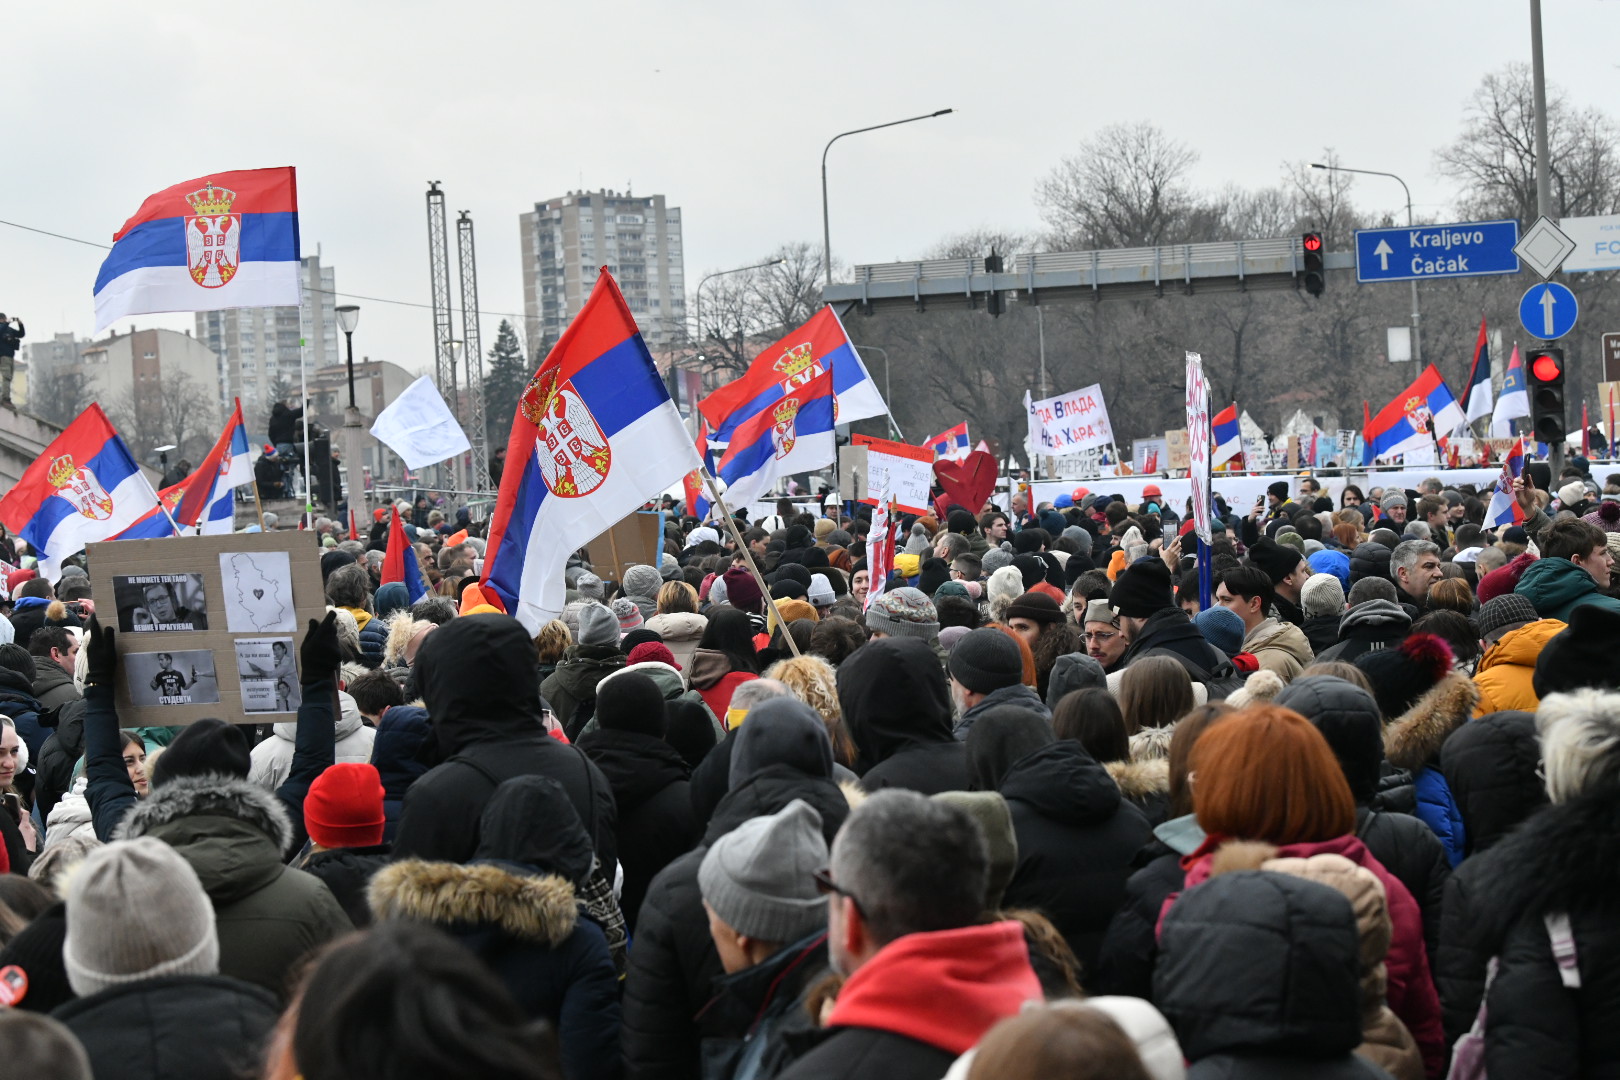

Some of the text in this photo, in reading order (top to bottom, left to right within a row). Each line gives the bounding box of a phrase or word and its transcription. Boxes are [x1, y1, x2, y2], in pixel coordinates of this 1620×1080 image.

[1409, 231, 1484, 250] Kraljevo
[1411, 254, 1469, 274] Čačak
[1054, 395, 1097, 419] ВЛАДА
[1062, 424, 1096, 445] ХАРА
[912, 471, 929, 482] 2025
[128, 575, 187, 584] НЕ МОЖЕТЕ ТЕК ТАКО
[134, 624, 154, 632] ПЕШКЕ
[159, 623, 194, 631] КРАГУЈЕВАЦ
[159, 695, 192, 705] СТУДЕНТИ
